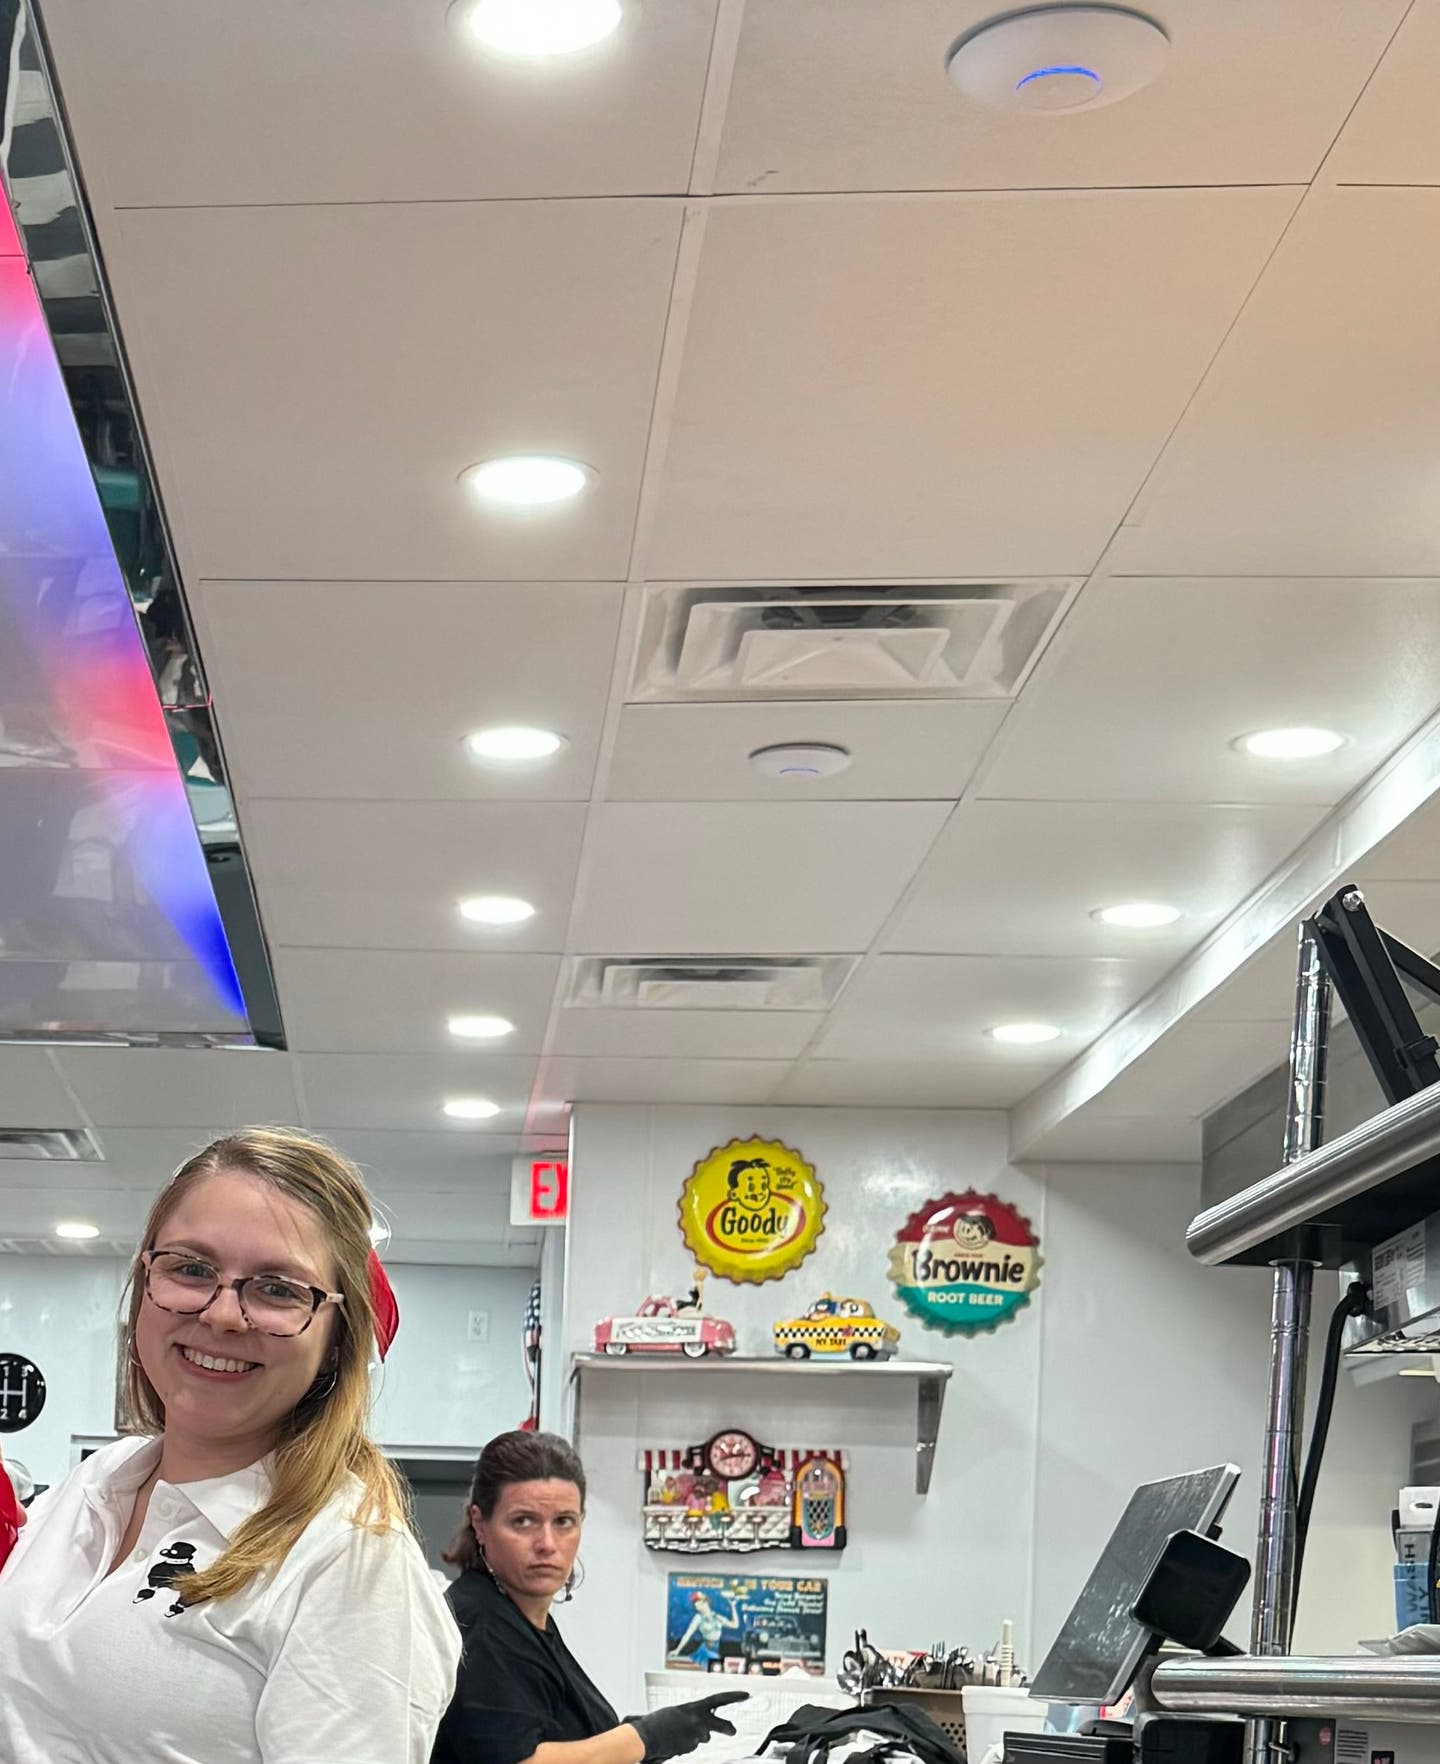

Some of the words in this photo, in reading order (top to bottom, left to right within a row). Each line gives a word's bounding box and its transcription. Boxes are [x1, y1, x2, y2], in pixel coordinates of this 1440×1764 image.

[721, 1206, 789, 1238] Goody
[911, 1250, 1025, 1283] Brownie
[928, 1292, 966, 1304] ROOT
[969, 1293, 1004, 1305] BEER
[3, 1365, 10, 1377] 1
[0, 1408, 9, 1420] 2
[18, 1408, 27, 1420] 4
